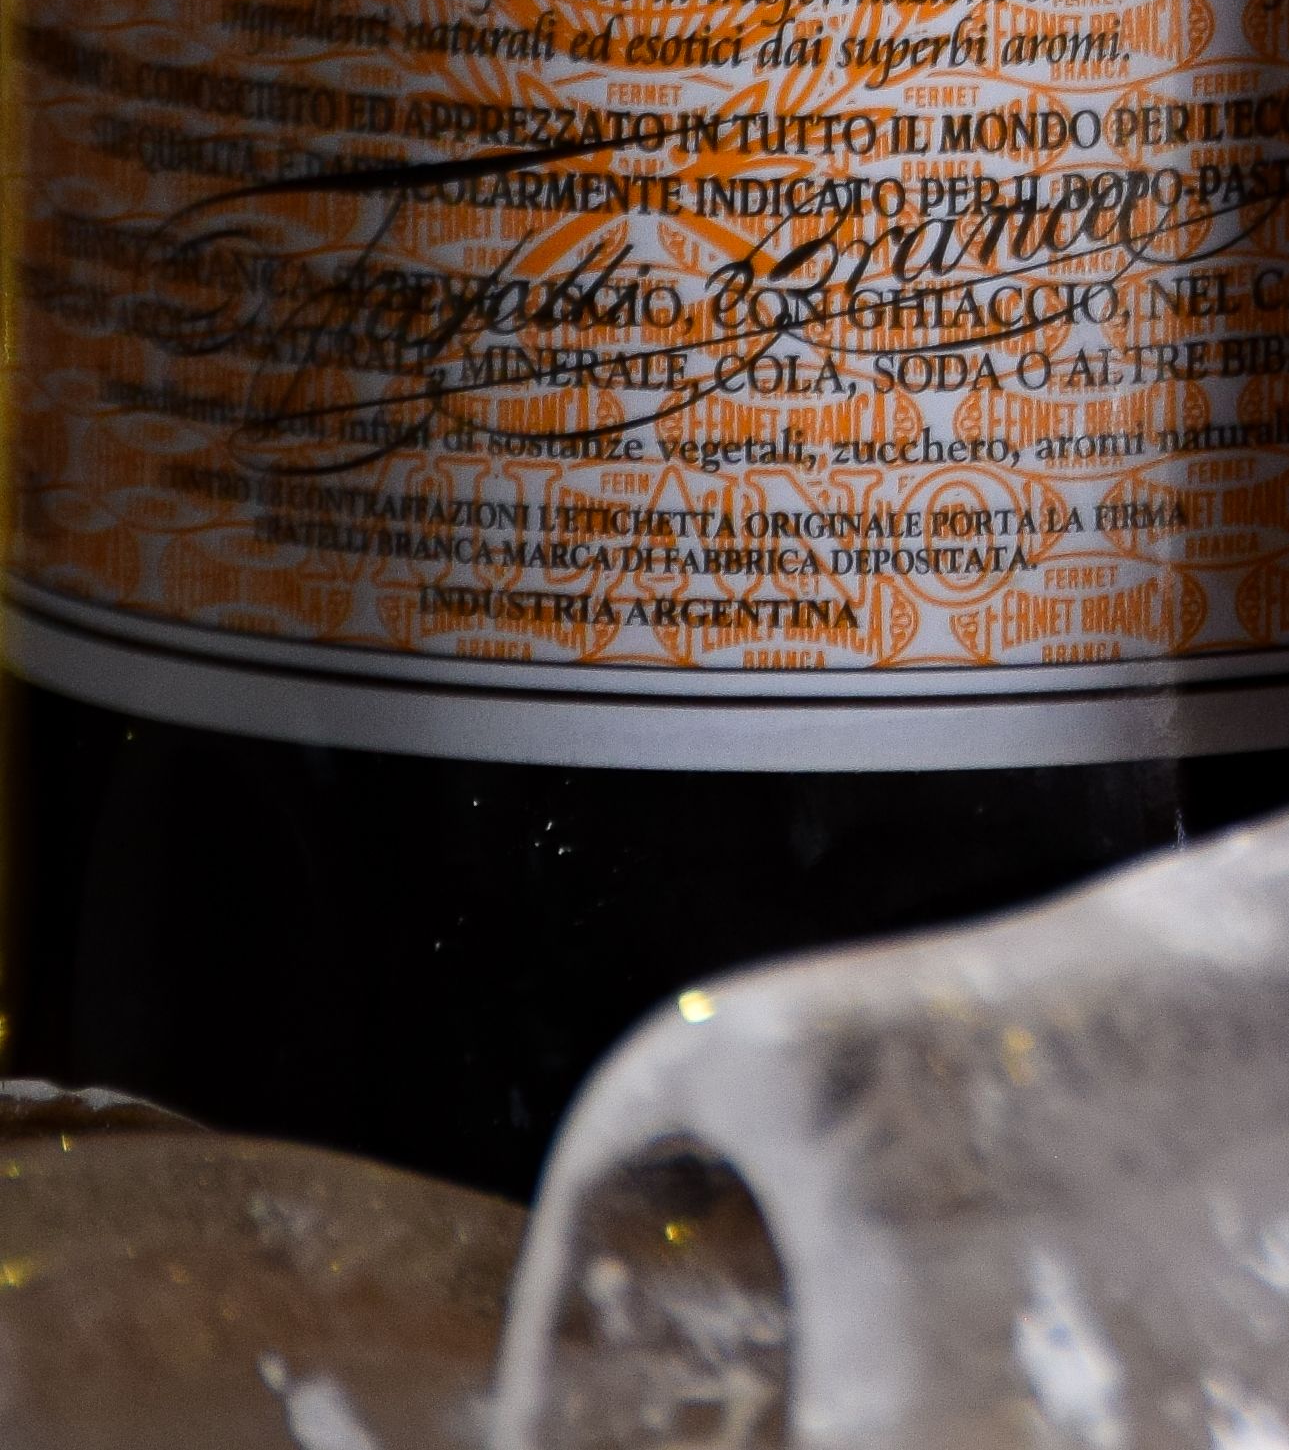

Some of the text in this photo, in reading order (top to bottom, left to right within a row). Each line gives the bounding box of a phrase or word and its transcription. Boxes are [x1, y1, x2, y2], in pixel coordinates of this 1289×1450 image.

[404, 9, 556, 62] naturali
[569, 14, 612, 65] ed
[625, 18, 744, 69] esotici
[756, 17, 824, 68] dai
[837, 16, 988, 89] superbi
[1000, 21, 1131, 69] aromi.
[346, 90, 395, 133] ED
[404, 101, 665, 152] APPREZZATO
[678, 108, 720, 155] IN
[730, 111, 877, 157] TUTTO
[888, 112, 930, 157] IL
[940, 106, 1103, 156] MONDO
[1113, 99, 1191, 149] PER
[304, 151, 684, 217] PARCOLARMENTE
[694, 173, 907, 220] INDICATO
[918, 176, 998, 220] PER
[710, 286, 831, 334] CON
[847, 281, 1131, 335] GHIACCIO,
[1148, 272, 1239, 321] NEL
[459, 344, 698, 395] MINERALE,
[714, 351, 857, 398] COLA,
[873, 351, 1003, 396] SODA
[1015, 346, 1053, 393] O
[1067, 334, 1209, 389] ALTRE
[441, 413, 480, 455] di
[488, 421, 645, 464] sostanze
[656, 426, 819, 473] vegetali,
[830, 426, 1021, 469] zucchero,
[1033, 420, 1146, 462] aromi
[538, 503, 735, 538] L'ETICHETTA
[744, 509, 922, 539] ORIGINALE
[932, 506, 1037, 538] PORTA
[1043, 504, 1084, 534] LA
[1093, 500, 1189, 533] FIRMA
[377, 528, 495, 566] BRANCA
[501, 541, 612, 573] MARCA
[619, 546, 656, 574] DI
[662, 546, 819, 577] FABBRICA
[829, 542, 1038, 576] DEPOSITATA.
[419, 583, 860, 630] INDUSTRIA ARGENTINA
